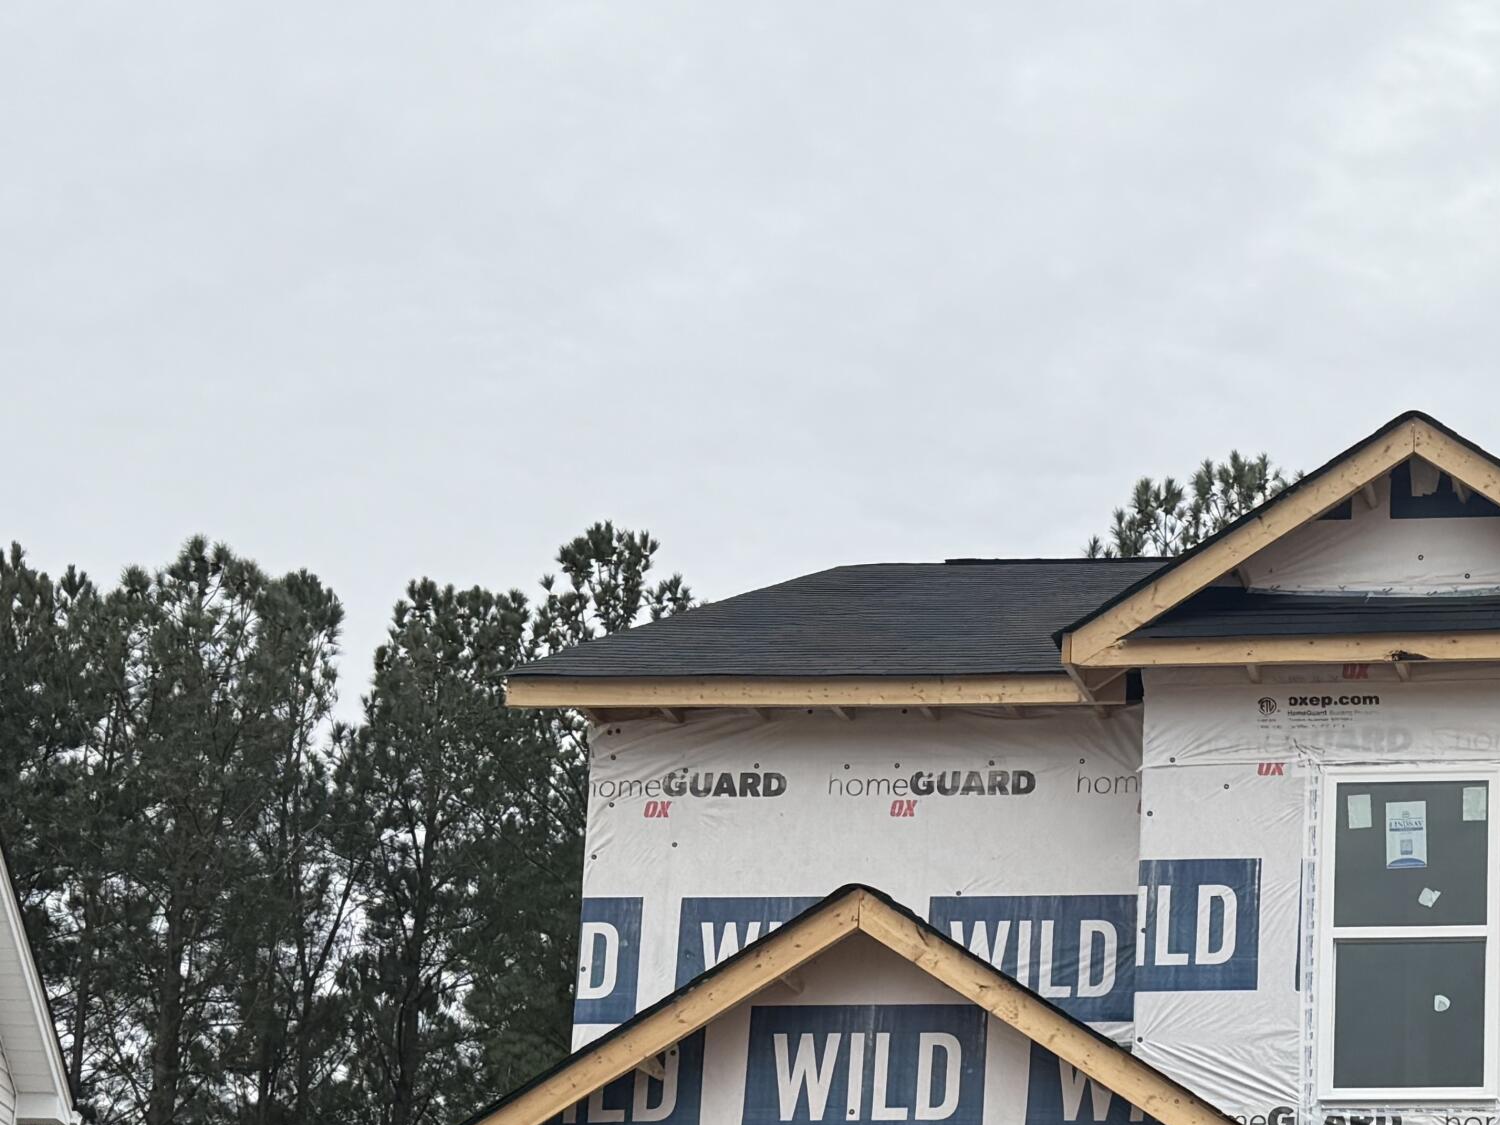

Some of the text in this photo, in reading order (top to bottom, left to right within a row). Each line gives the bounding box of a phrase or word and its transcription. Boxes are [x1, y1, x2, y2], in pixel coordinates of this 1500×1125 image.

[1288, 694, 1380, 708] oxep.com
[828, 770, 1036, 796] homeGUARD
[643, 801, 673, 818] OX
[889, 800, 918, 817] OX
[774, 1032, 962, 1121] WILD
